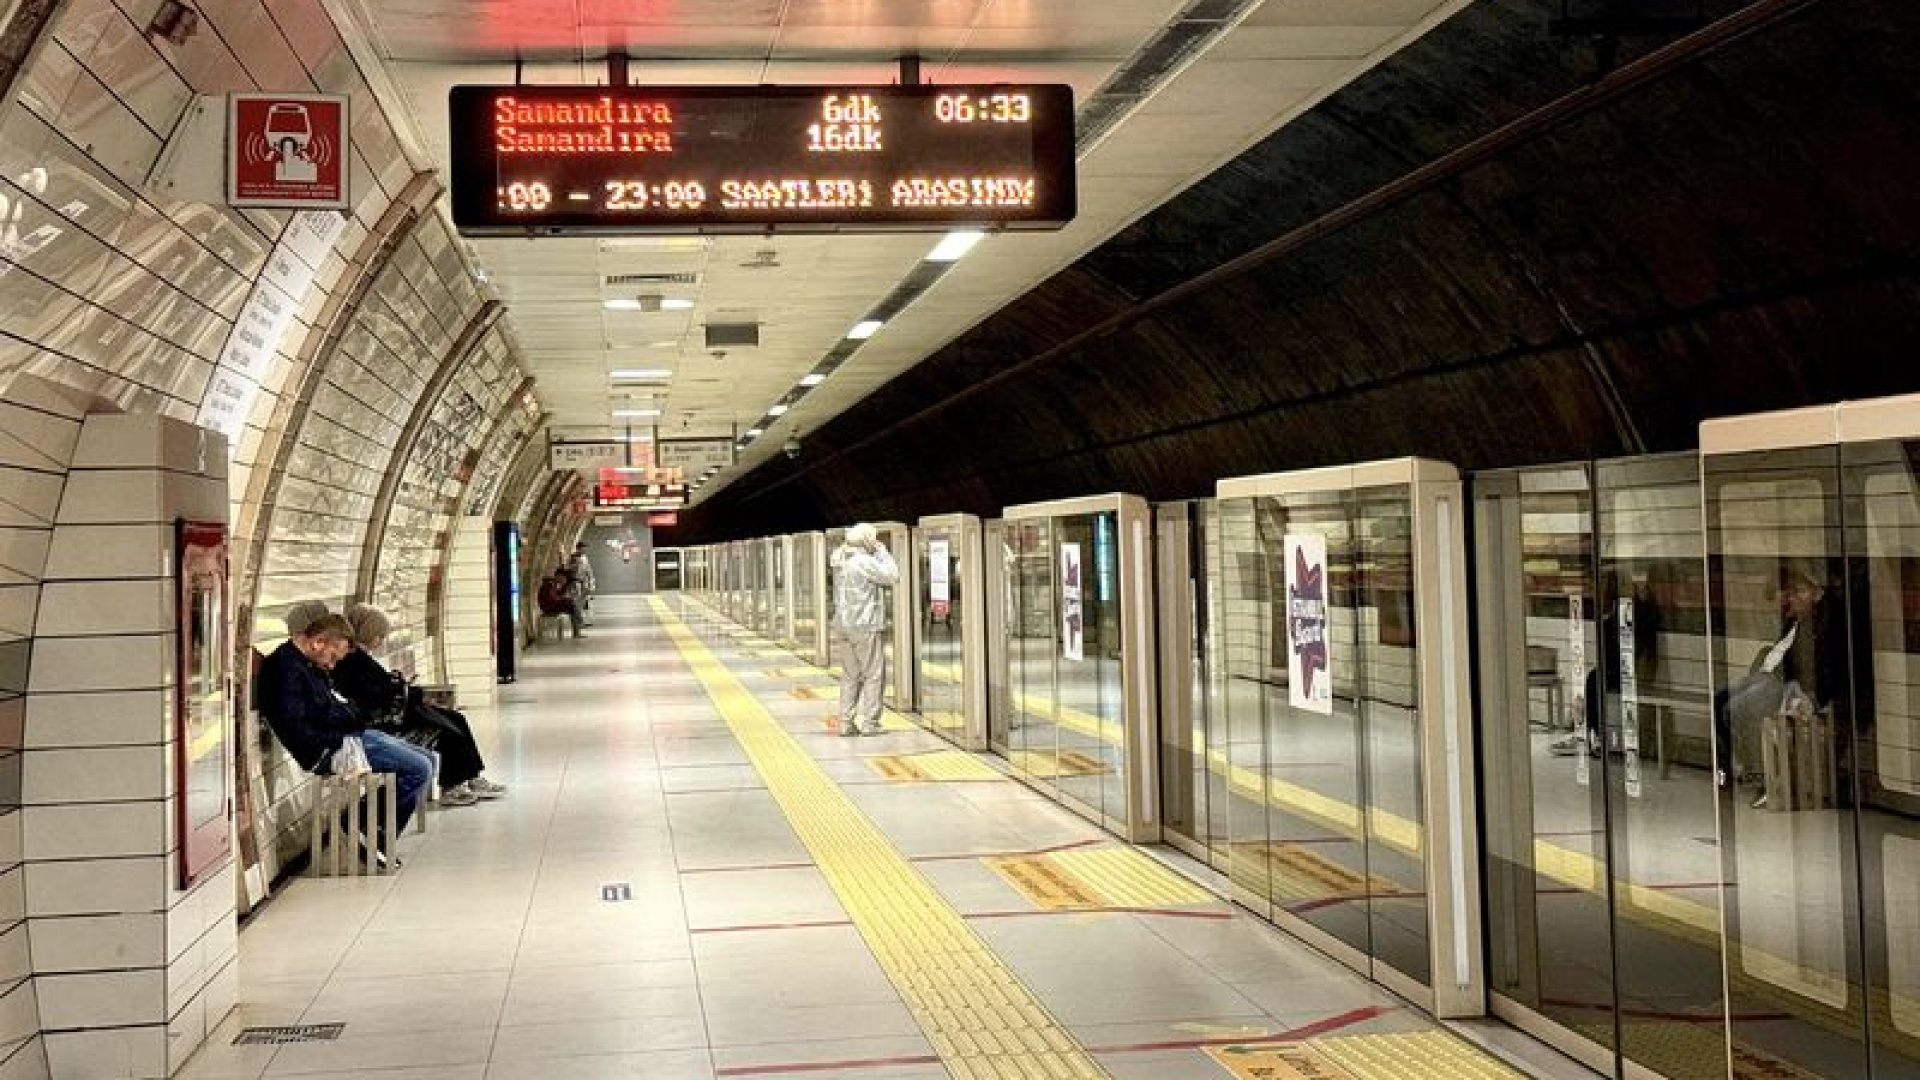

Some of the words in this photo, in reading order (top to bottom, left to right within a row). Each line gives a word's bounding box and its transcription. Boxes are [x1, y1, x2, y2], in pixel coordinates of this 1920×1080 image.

[496, 96, 672, 123] Samandıra
[822, 95, 882, 122] 6dk
[934, 93, 1030, 122] 06:33
[496, 126, 672, 152] Samandıra
[807, 124, 882, 152] 16dk
[498, 181, 552, 210] :00
[605, 180, 707, 210] 23:00
